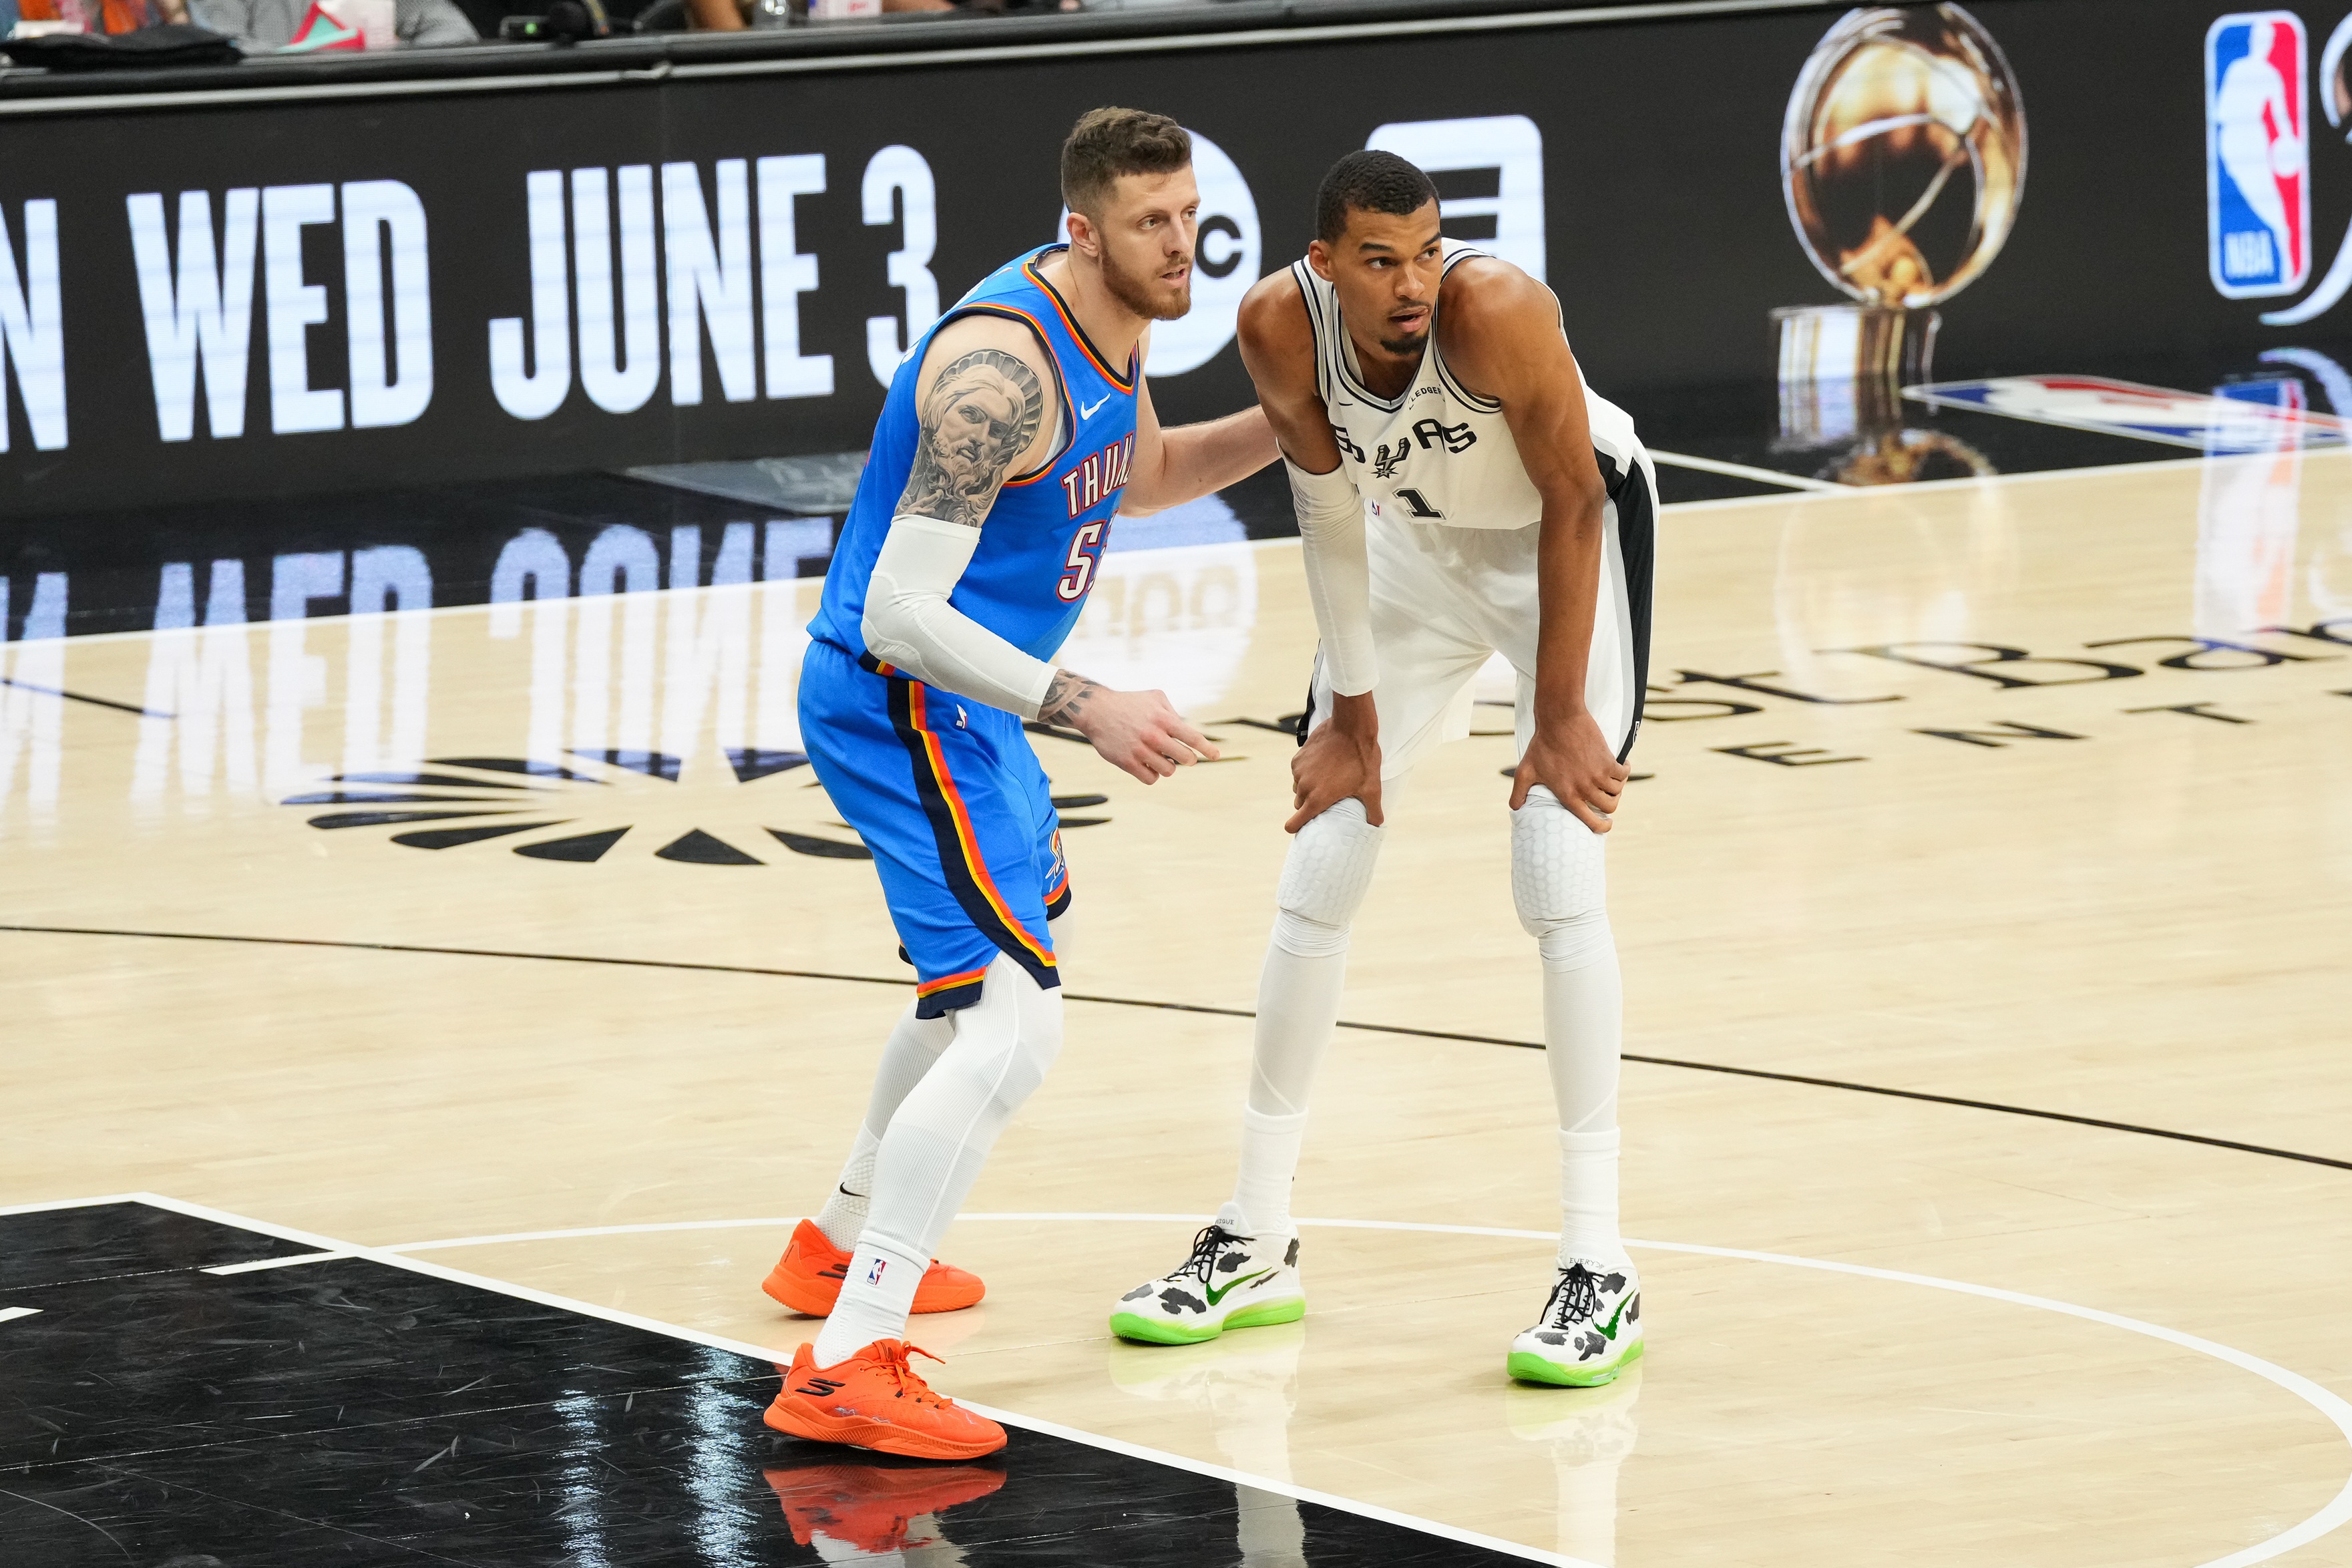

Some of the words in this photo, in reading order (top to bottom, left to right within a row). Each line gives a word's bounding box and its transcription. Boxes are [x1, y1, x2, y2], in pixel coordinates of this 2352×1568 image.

[127, 180, 433, 441] WED
[488, 154, 834, 421] JUNE
[861, 144, 940, 393] 3
[1411, 386, 1442, 402] LEDGER
[1060, 431, 1135, 520] THUN
[1392, 487, 1446, 520] 1
[1056, 508, 1119, 603] 5
